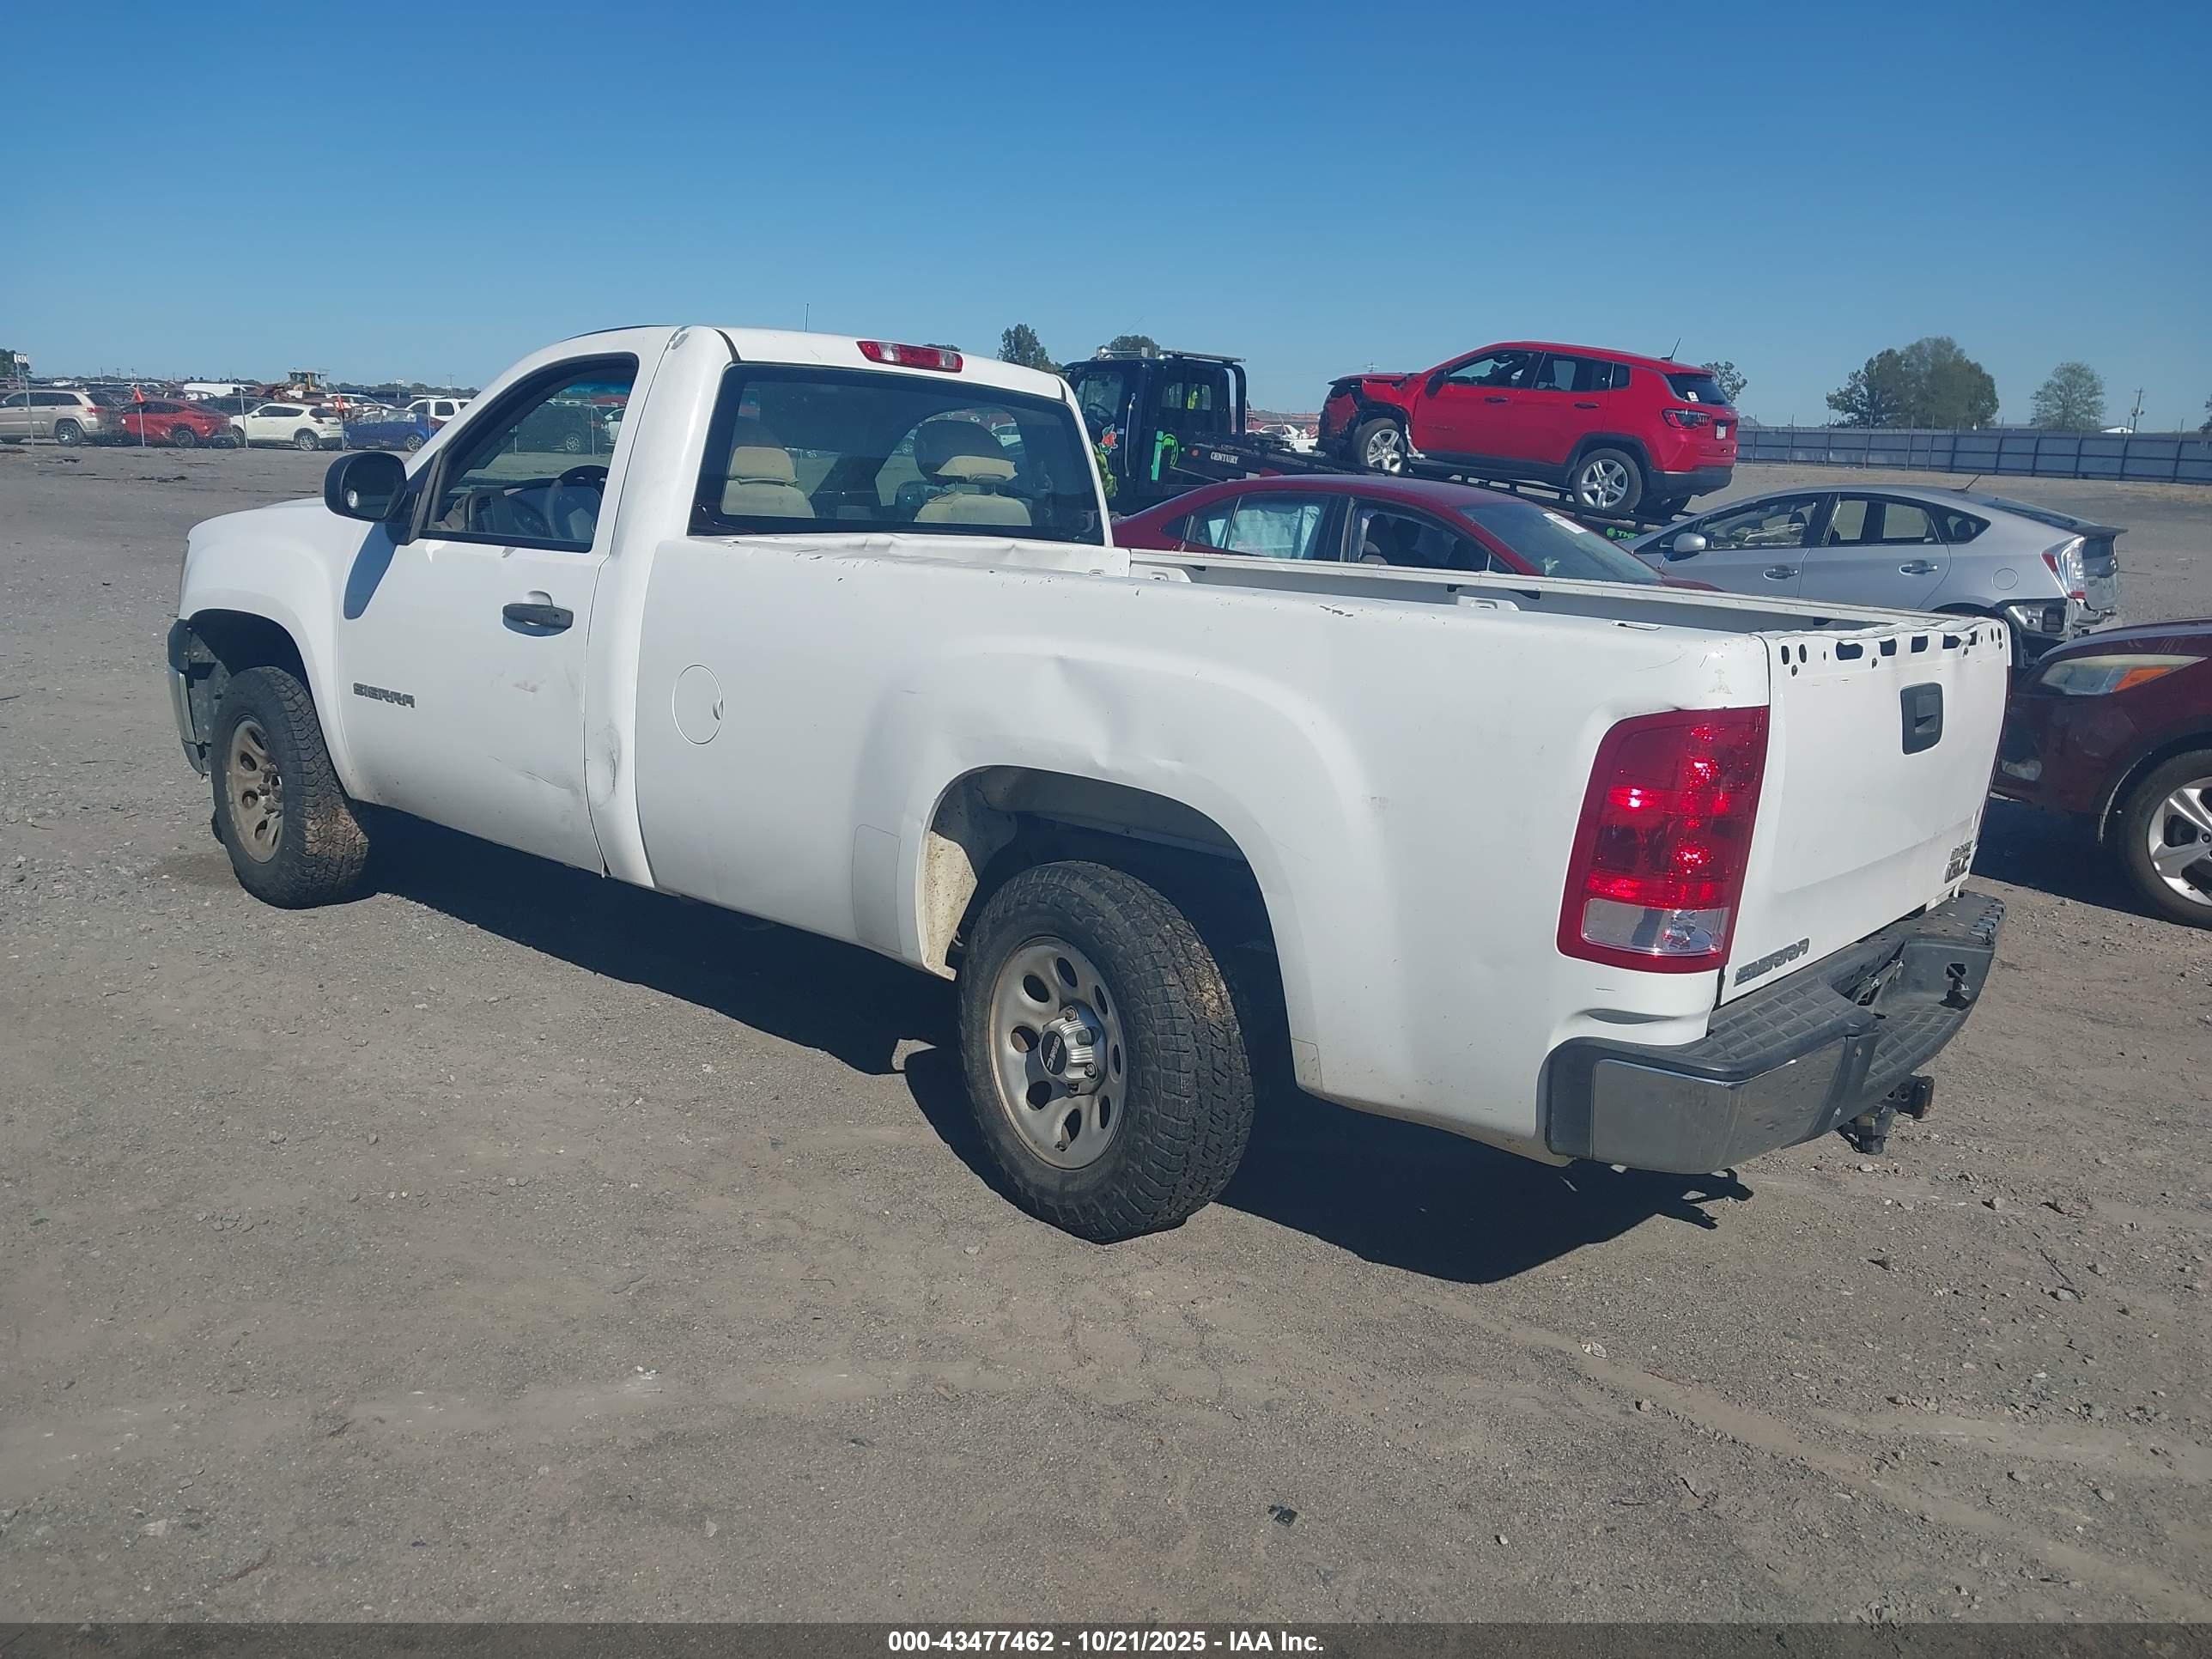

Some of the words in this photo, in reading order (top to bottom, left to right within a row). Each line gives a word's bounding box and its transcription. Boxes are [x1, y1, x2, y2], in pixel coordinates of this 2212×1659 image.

[1210, 452, 1238, 464] CENTURY
[353, 682, 416, 708] SIERRA
[1734, 937, 1810, 987] SIERRA
[1046, 1036, 1061, 1072] GMC
